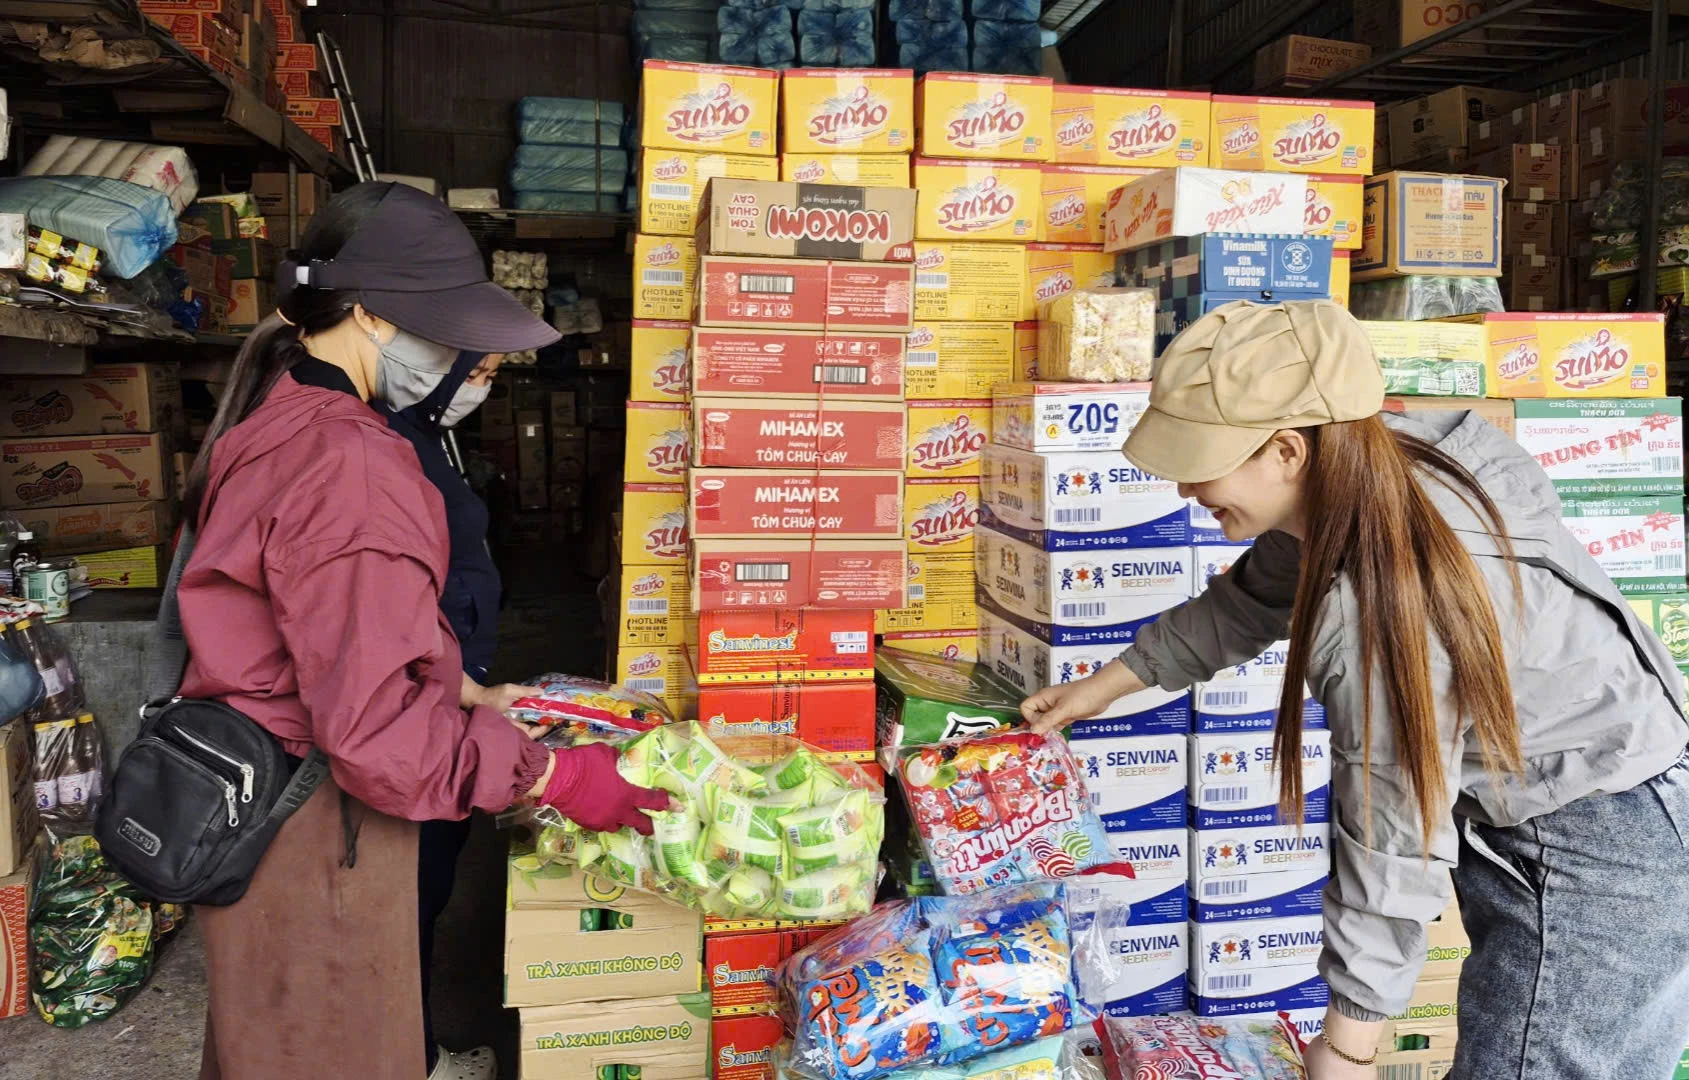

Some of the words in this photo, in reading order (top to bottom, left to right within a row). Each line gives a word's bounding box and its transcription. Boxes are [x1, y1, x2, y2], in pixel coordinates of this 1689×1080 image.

[1309, 44, 1353, 57] CHOCOLATE
[1309, 55, 1333, 68] mix
[732, 194, 756, 206] CAY
[654, 202, 691, 212] HOTLINE
[727, 206, 759, 217] CHUA
[730, 218, 757, 230] TÔM
[767, 207, 890, 242] KOKOMI
[1222, 239, 1267, 252] Vinamilk
[647, 288, 684, 298] HOTLINE
[1068, 402, 1119, 435] 502
[759, 420, 844, 438] MIHAMEX
[756, 447, 783, 462] TÔM
[823, 450, 848, 464] CAY
[755, 487, 840, 503] MIHAMEX
[1119, 484, 1150, 494] BEER
[751, 513, 779, 528] TÔM
[782, 516, 815, 529] CHUA
[818, 516, 843, 529] CAY
[1055, 537, 1065, 547] 24
[1192, 533, 1202, 543] 24
[1111, 561, 1184, 577] SENVINA
[995, 575, 1025, 601] SENVINA
[1120, 578, 1152, 589] BEER
[631, 617, 668, 625] HOTLINE
[708, 628, 796, 652] Sanvinest
[1062, 633, 1072, 642] 24
[996, 659, 1026, 689] SENVINA
[709, 714, 797, 735] Sanvinest
[1203, 719, 1214, 730] 24
[1106, 750, 1179, 767] SENVINA
[1116, 767, 1147, 778] BEER
[1203, 816, 1214, 826] 24
[1253, 836, 1323, 854] SENVINA
[1118, 844, 1181, 860] ENVINA
[1263, 855, 1292, 864] BEER
[1204, 910, 1215, 920] 24
[1109, 934, 1180, 954] SENVINA
[1258, 930, 1324, 949] SENVINA
[1267, 949, 1296, 960] BEER
[527, 963, 555, 979] TRÀ
[557, 961, 600, 978] XANH
[602, 955, 657, 974] KHÔNG
[660, 952, 683, 972] ĐỘ
[1208, 1004, 1219, 1014] 24
[1410, 1004, 1450, 1018] KHÔNG
[537, 1034, 563, 1050] TRÀ
[566, 1032, 611, 1049] XANH
[613, 1026, 666, 1044] KHÔNG
[669, 1021, 692, 1041] ĐỘ
